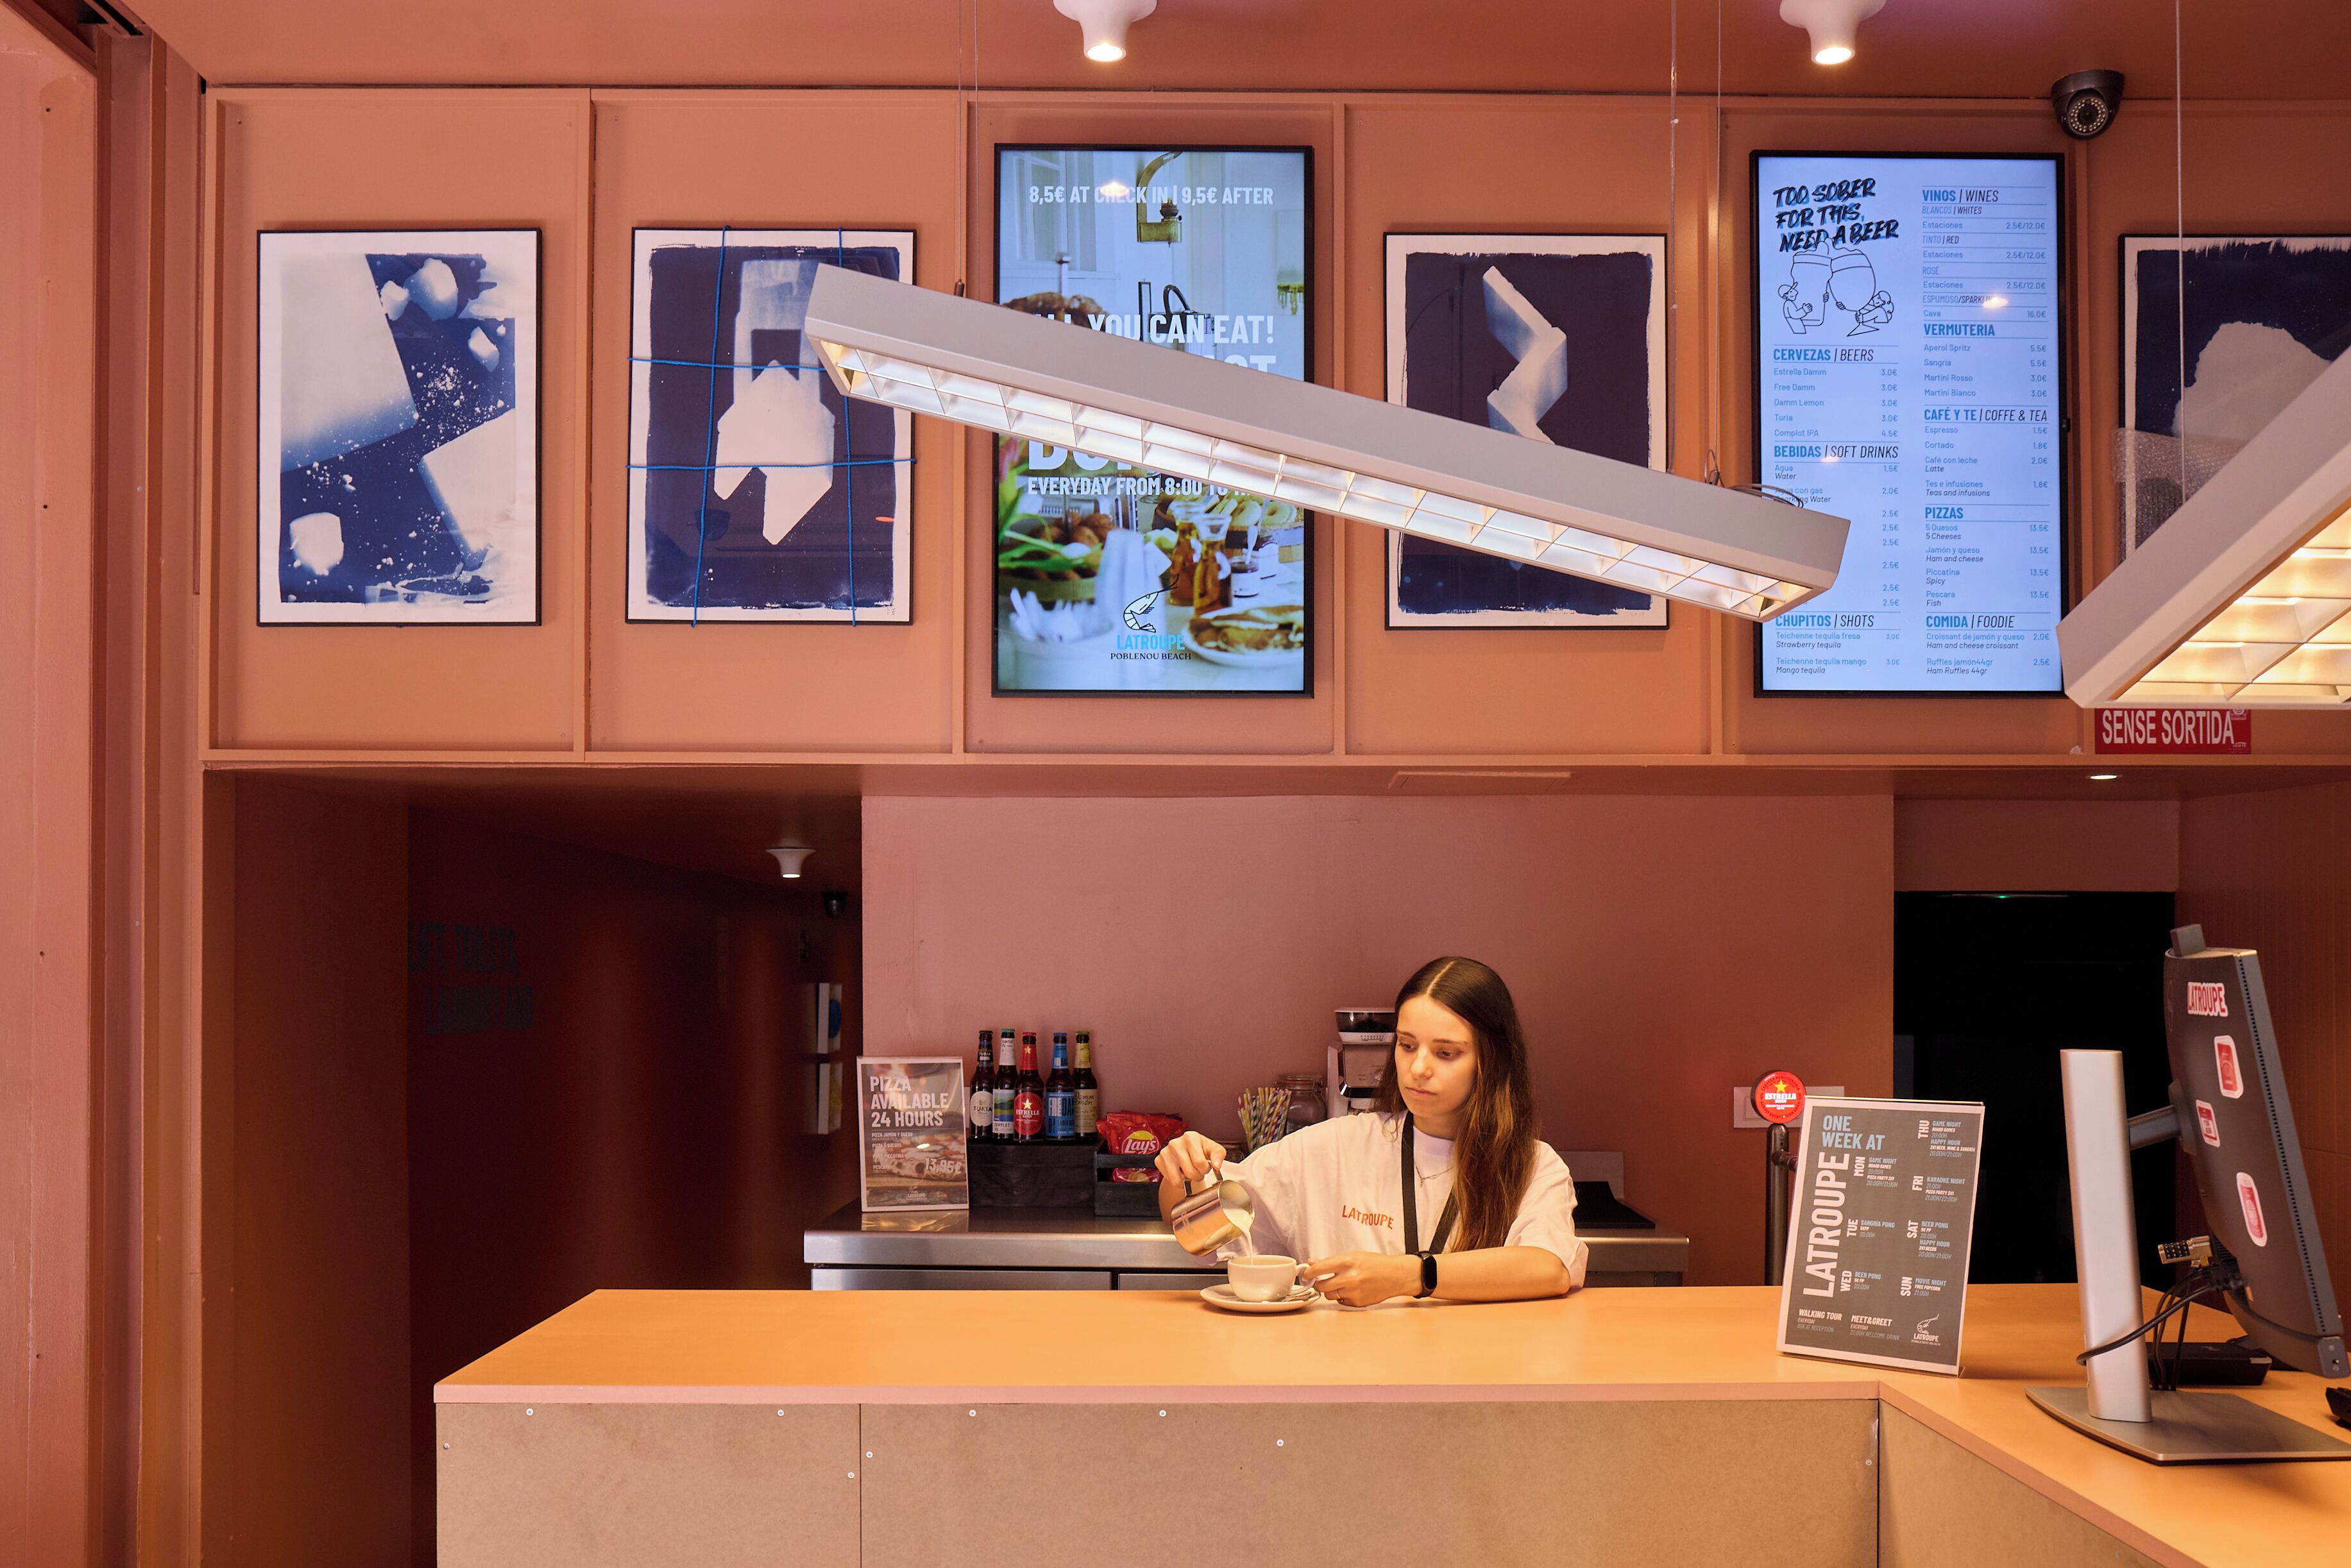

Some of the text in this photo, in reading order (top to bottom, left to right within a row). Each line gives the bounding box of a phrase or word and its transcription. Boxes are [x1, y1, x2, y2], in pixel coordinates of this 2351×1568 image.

[1029, 186, 1065, 205] 8,5€
[1069, 186, 1089, 203] AT
[1152, 187, 1168, 203] IN
[1182, 187, 1218, 207] 9,5€
[1221, 187, 1273, 205] AFTER
[1773, 178, 1876, 208] TOO SOBER
[1922, 190, 1999, 202] VINOS WINES
[1922, 206, 1982, 214] BLANCOS WHITES
[1776, 208, 1814, 229] FOR
[1779, 219, 1899, 252] NEED A BEER
[1149, 315, 1204, 343] CAN
[1214, 315, 1274, 344] EAT!
[1924, 324, 1995, 336] VERMUTERIA
[1773, 348, 1874, 361] CERVEZAS BEERS
[1924, 344, 1948, 353] Aperol
[1949, 344, 1971, 353] Spritz
[1924, 407, 2048, 421] CAFÉ Y TE COFFE TEA
[1774, 430, 1805, 438] Complot
[1924, 426, 1958, 435] Espresso
[1774, 446, 1899, 459] BEBIDAS SOFT DRINKS
[1775, 464, 1794, 473] Agua
[1028, 476, 1112, 495] EVERYDAY
[1116, 477, 1160, 495] FROM
[1165, 477, 1202, 496] 8:00
[1925, 507, 1964, 519] PIZZAS
[1926, 577, 1946, 586] Spicy
[1776, 615, 1874, 627] CHUPITOS SHOTS
[1926, 616, 2015, 628] COMIDA FOODIE
[1117, 634, 1185, 650] LATROUPE
[1815, 632, 1840, 641] tequila
[1776, 641, 1841, 650] Strawberry tequila
[1110, 652, 1159, 661] POBLENOU
[1776, 666, 1800, 675] Mango
[2102, 710, 2234, 744] SENSE SORTIDA
[2188, 986, 2226, 1013] LATROUPE
[870, 1075, 912, 1092] PIZZA
[870, 1093, 949, 1109] AVAILABLE
[871, 1110, 944, 1127] 24 HOURS
[1822, 1115, 1852, 1132] ONE
[1918, 1120, 1930, 1139] THU
[1125, 1138, 1157, 1155] Lay's
[1822, 1132, 1885, 1151] WEEK AT
[1853, 1156, 1865, 1177] MON
[1912, 1176, 1924, 1191] FRI
[1342, 1205, 1395, 1229] LATROUPE
[1803, 1152, 1850, 1298] LATROUPE
[1846, 1218, 1858, 1237] TUE
[1906, 1220, 1919, 1239] SAT
[1840, 1270, 1852, 1292] WED
[1900, 1276, 1912, 1297] SUN
[1799, 1308, 1842, 1321] WALKING TOUR
[1851, 1315, 1893, 1327] MEET&GREET
[1914, 1333, 1939, 1342] LATROUPE
